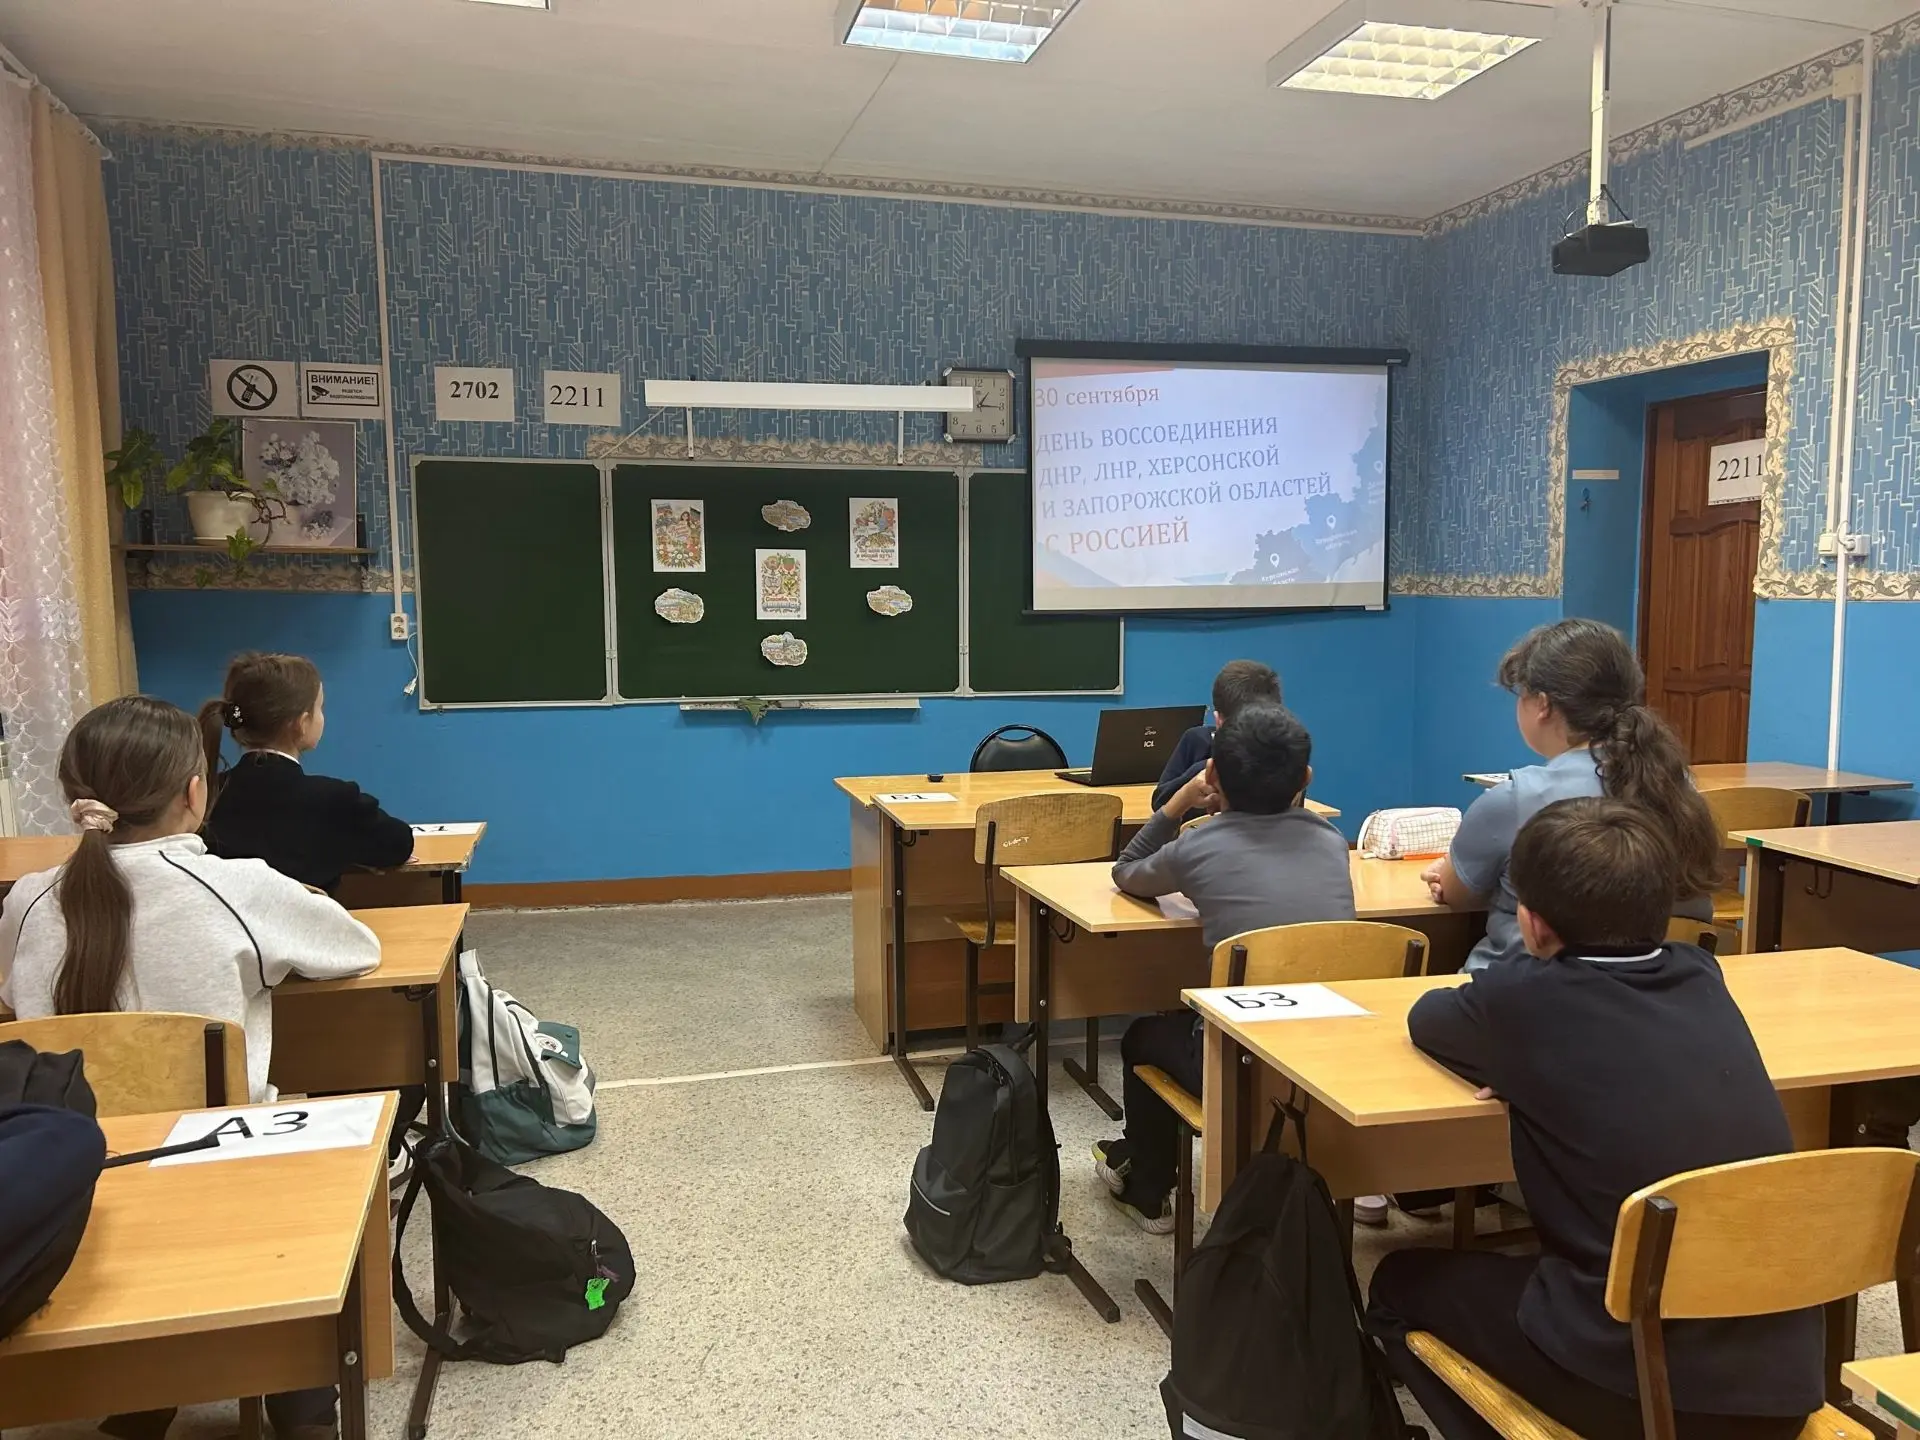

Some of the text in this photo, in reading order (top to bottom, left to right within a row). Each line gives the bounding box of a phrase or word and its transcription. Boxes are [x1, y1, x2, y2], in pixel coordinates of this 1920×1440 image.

[311, 374, 375, 385] ВНИМАНИЕ!
[974, 378, 983, 388] 12
[450, 380, 500, 399] 2702
[549, 385, 604, 408] 2211
[999, 388, 1005, 397] 2
[1035, 384, 1161, 408] 30 сентября
[953, 416, 959, 426] 8
[961, 424, 967, 433] 7
[976, 424, 982, 434] 6
[991, 424, 997, 434] 5
[1000, 418, 1005, 427] 4
[1036, 416, 1278, 456] ДЕНЬ ВОССОЕДИНЕНИЯ
[1038, 444, 1280, 490] ДНР, ЛНР, ХЕРСОНСКОЙ
[1716, 454, 1763, 482] 2211
[1042, 501, 1057, 520] И
[1063, 481, 1222, 518] ЗАПОРОЖСКОЙ
[1228, 471, 1332, 501] ОБЛАСТЕЙ
[1045, 516, 1190, 555] С РОССИЕЙ
[1223, 991, 1299, 1009] Б3
